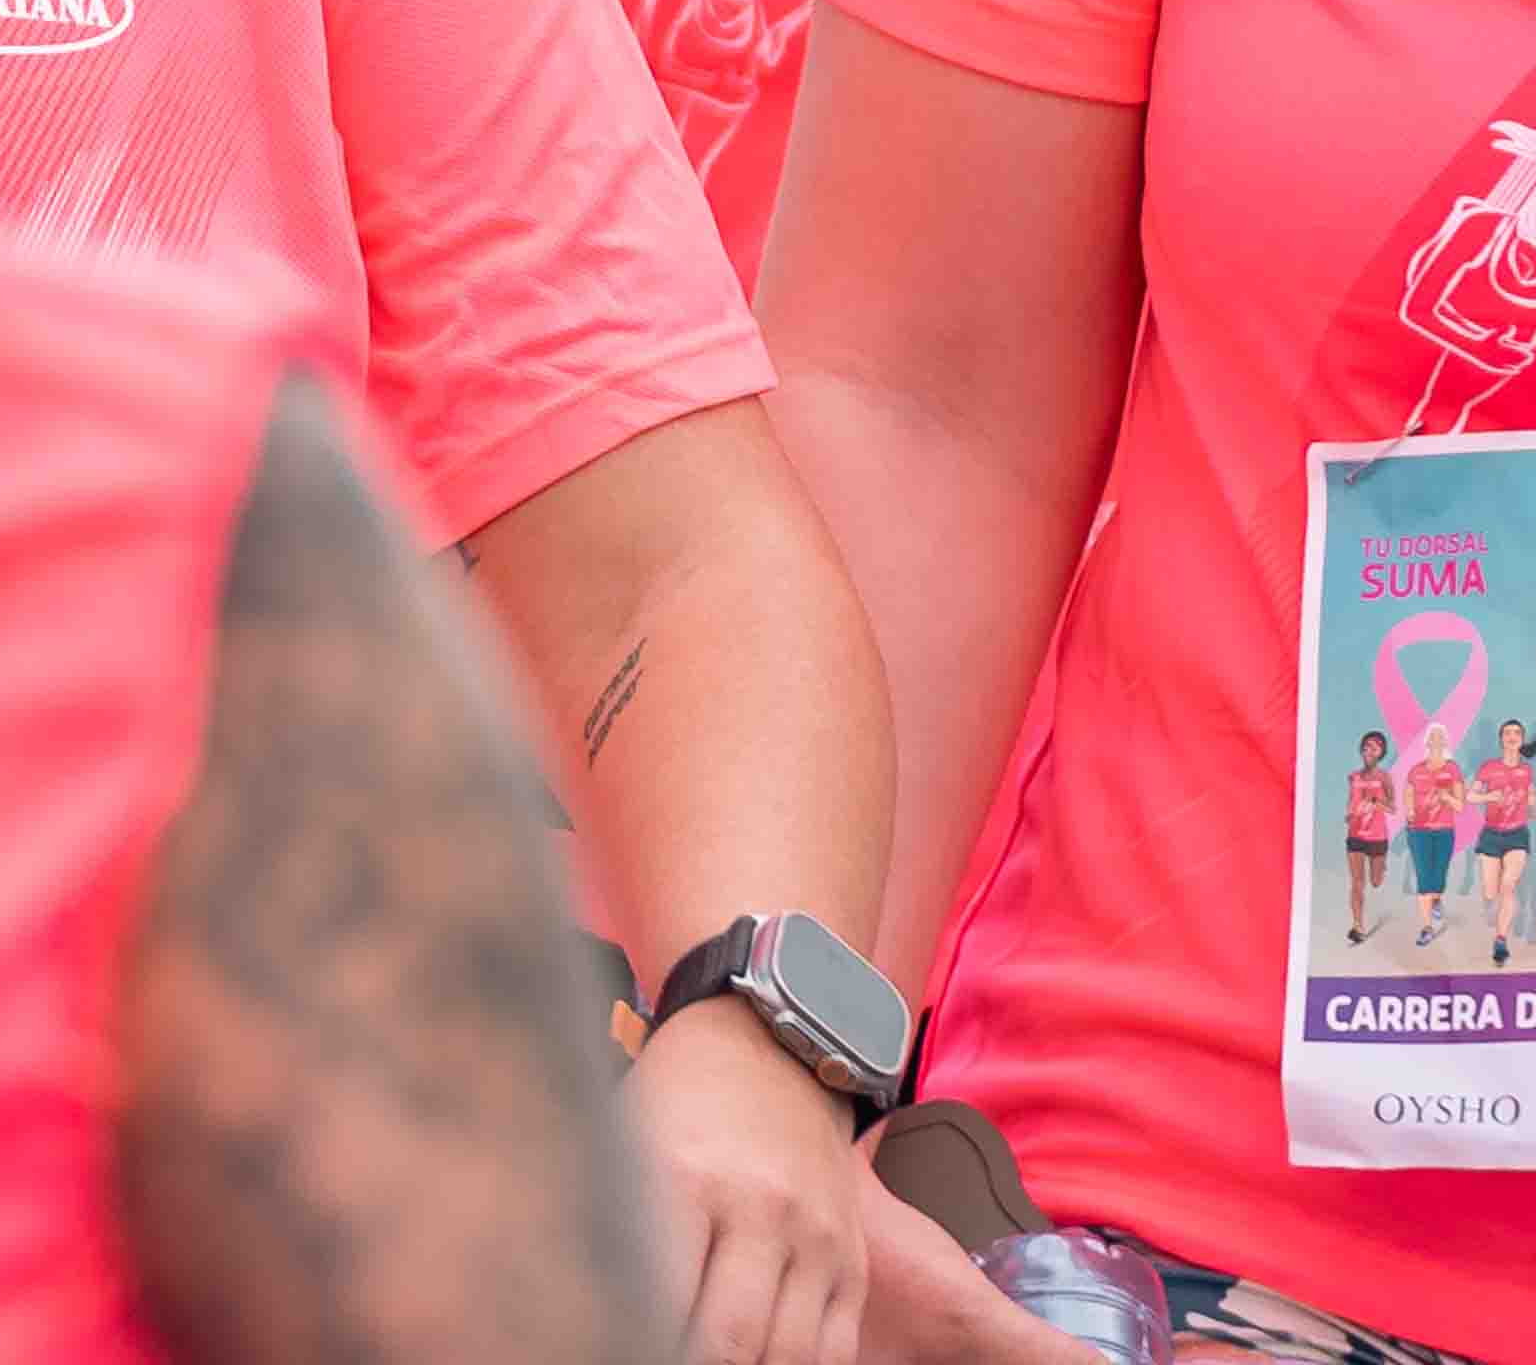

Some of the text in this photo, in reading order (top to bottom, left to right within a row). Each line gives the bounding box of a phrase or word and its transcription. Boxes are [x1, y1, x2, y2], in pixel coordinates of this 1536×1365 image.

[1359, 531, 1490, 559] TU DORSAL
[1359, 558, 1489, 603] SUMA
[1326, 993, 1504, 1032] CARRERA
[1373, 1092, 1522, 1126] OYSHO
